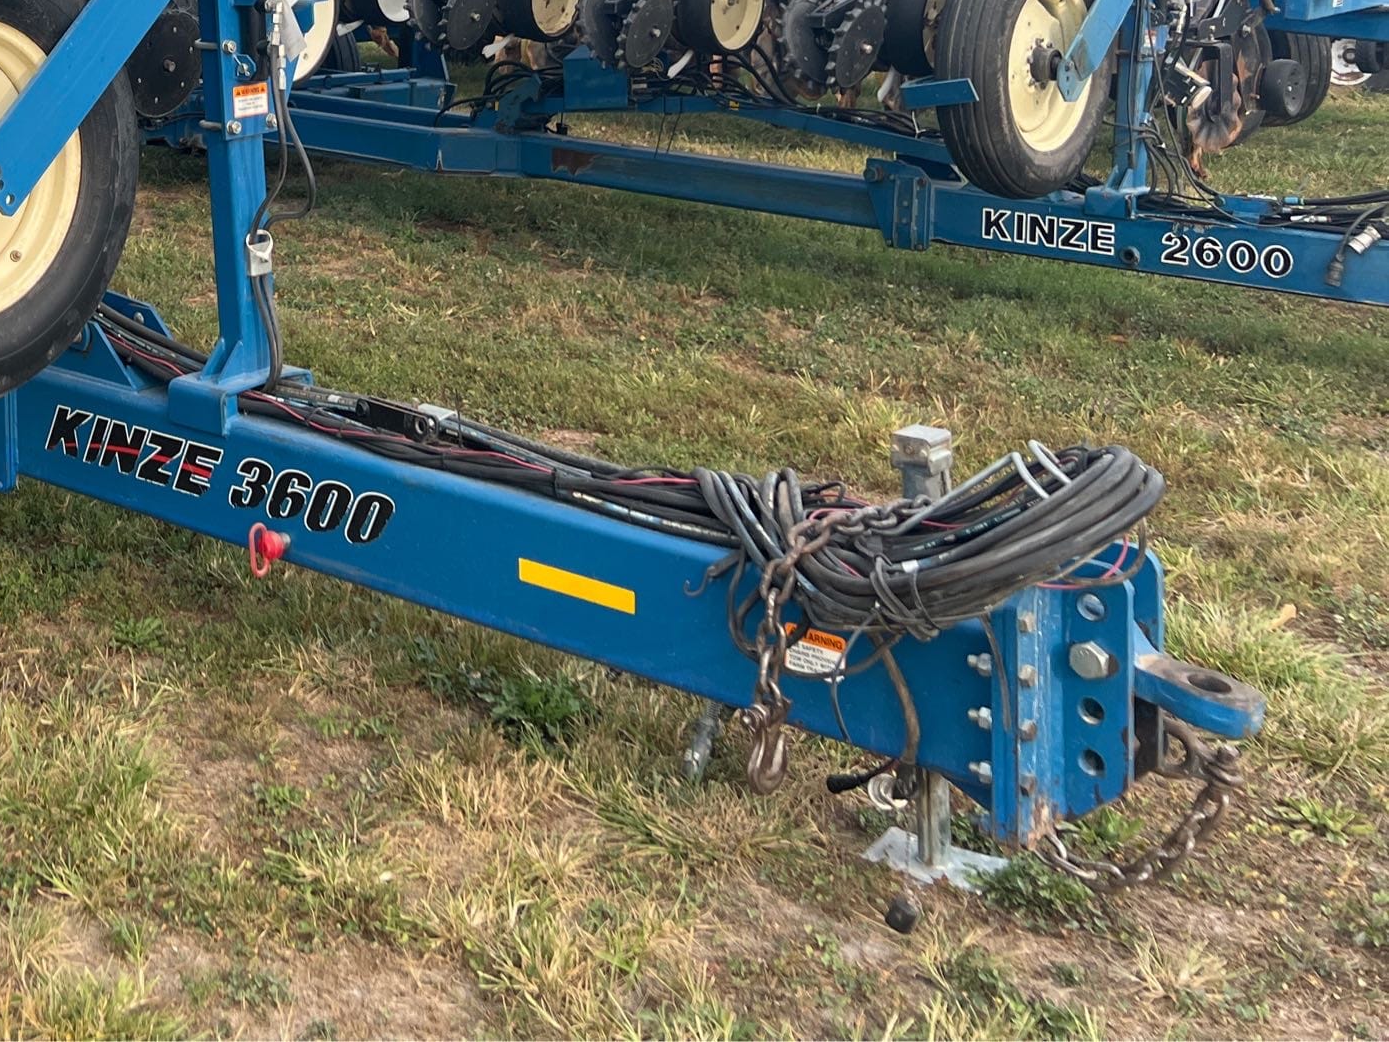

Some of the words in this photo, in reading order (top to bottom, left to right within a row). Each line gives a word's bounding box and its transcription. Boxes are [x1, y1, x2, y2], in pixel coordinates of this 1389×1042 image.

[982, 207, 1116, 256] KINZE
[1161, 232, 1294, 279] 2600
[44, 404, 223, 497] KINZE
[228, 457, 396, 545] 3600
[808, 632, 843, 650] ARNING
